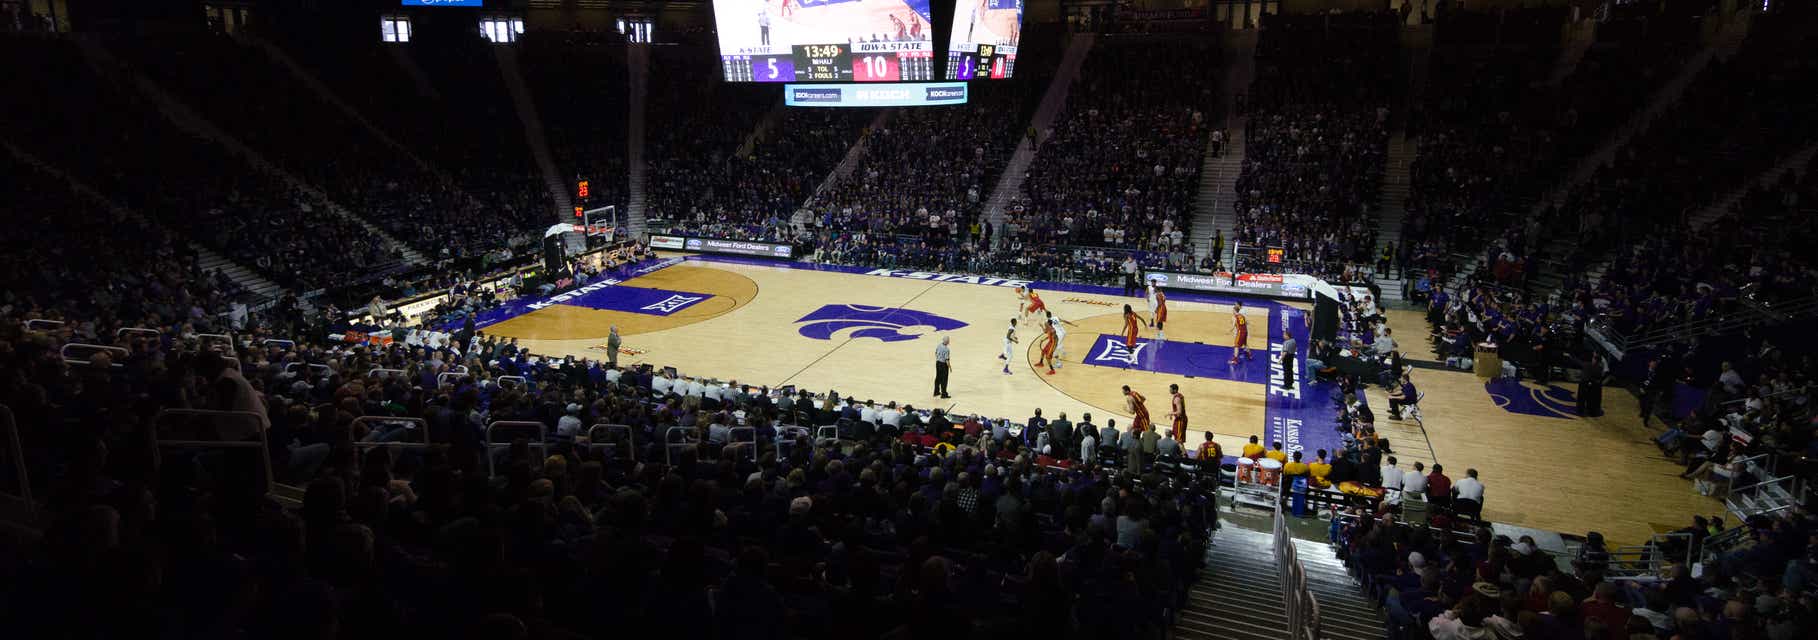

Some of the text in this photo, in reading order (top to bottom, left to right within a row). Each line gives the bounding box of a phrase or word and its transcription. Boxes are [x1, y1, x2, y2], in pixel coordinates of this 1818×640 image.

[803, 45, 838, 58] 13:49
[861, 42, 922, 51] IOWA STATE
[767, 57, 779, 79] 5
[863, 56, 888, 78] 10
[706, 240, 732, 248] Midwest
[746, 243, 770, 251] Dealers
[1177, 275, 1214, 285] Midwest
[1238, 280, 1272, 289] Dealers
[526, 277, 622, 310] K-STATE
